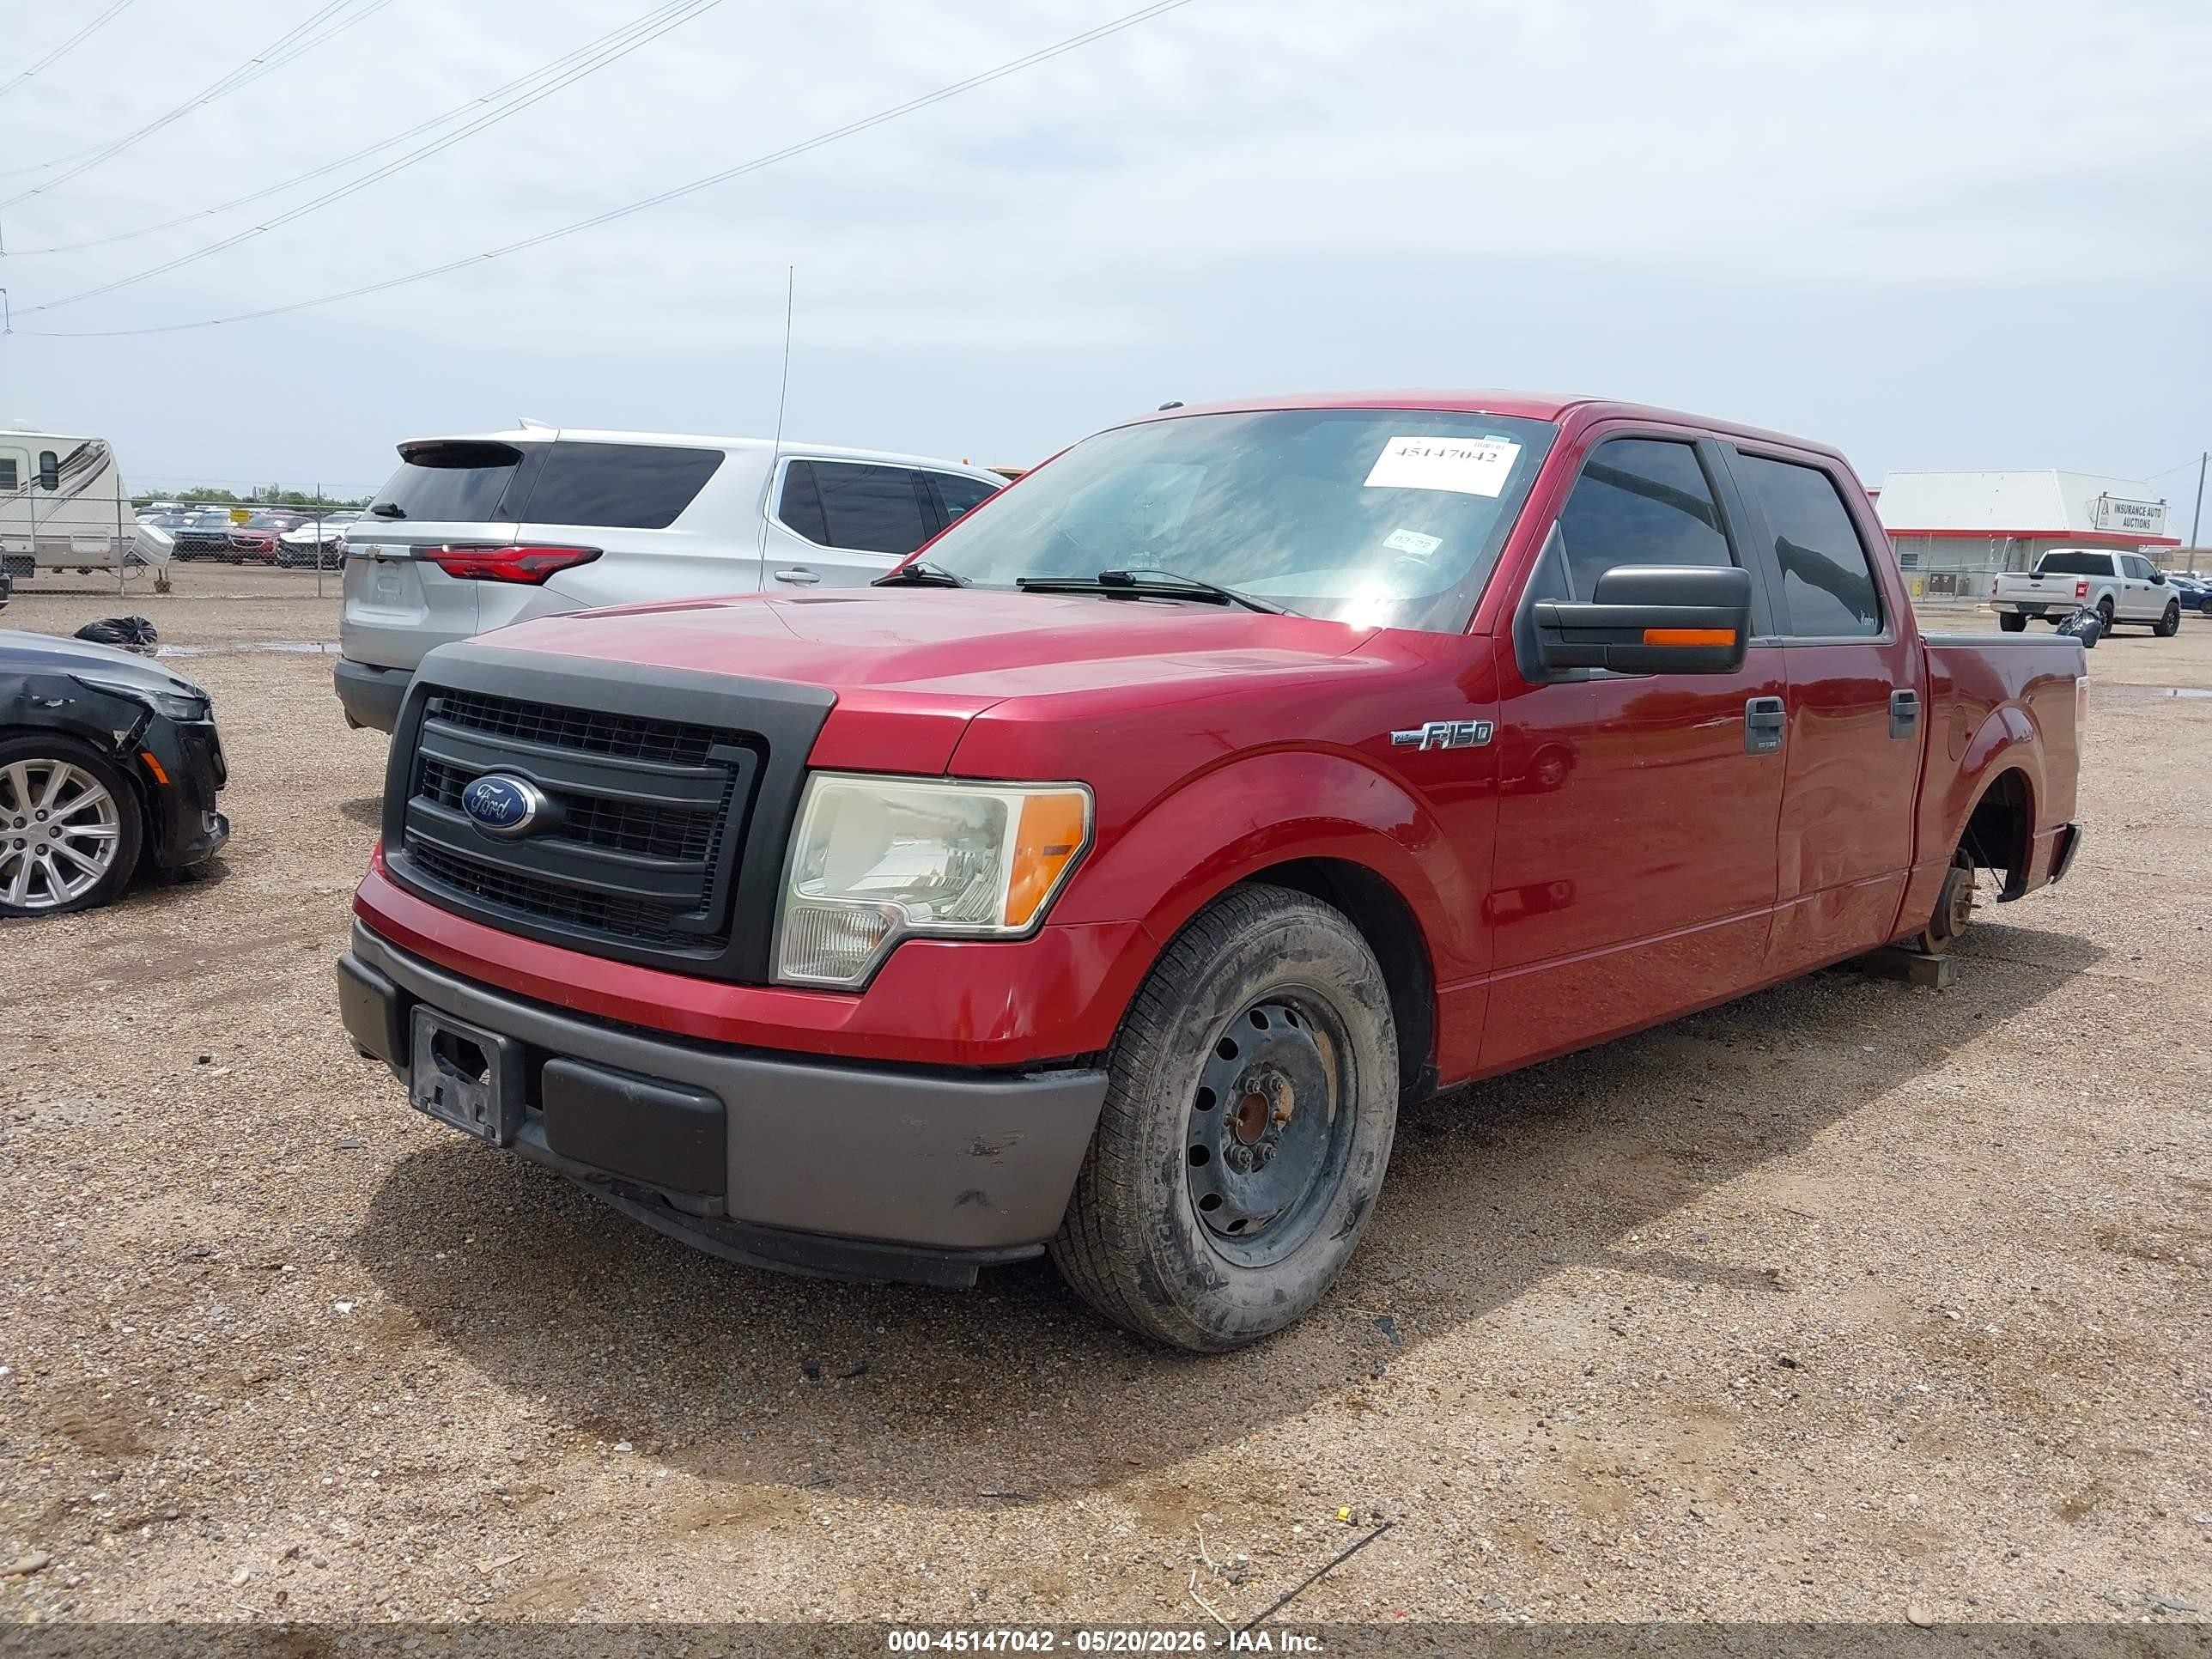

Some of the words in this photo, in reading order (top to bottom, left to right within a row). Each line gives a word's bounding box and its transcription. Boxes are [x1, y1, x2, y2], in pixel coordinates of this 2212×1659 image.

[1395, 447, 1498, 462] 45147042
[2114, 503, 2146, 517] INSURANCE
[2147, 508, 2161, 518] AUTO
[2123, 517, 2150, 529] AUCTIONS
[471, 783, 512, 819] Ford
